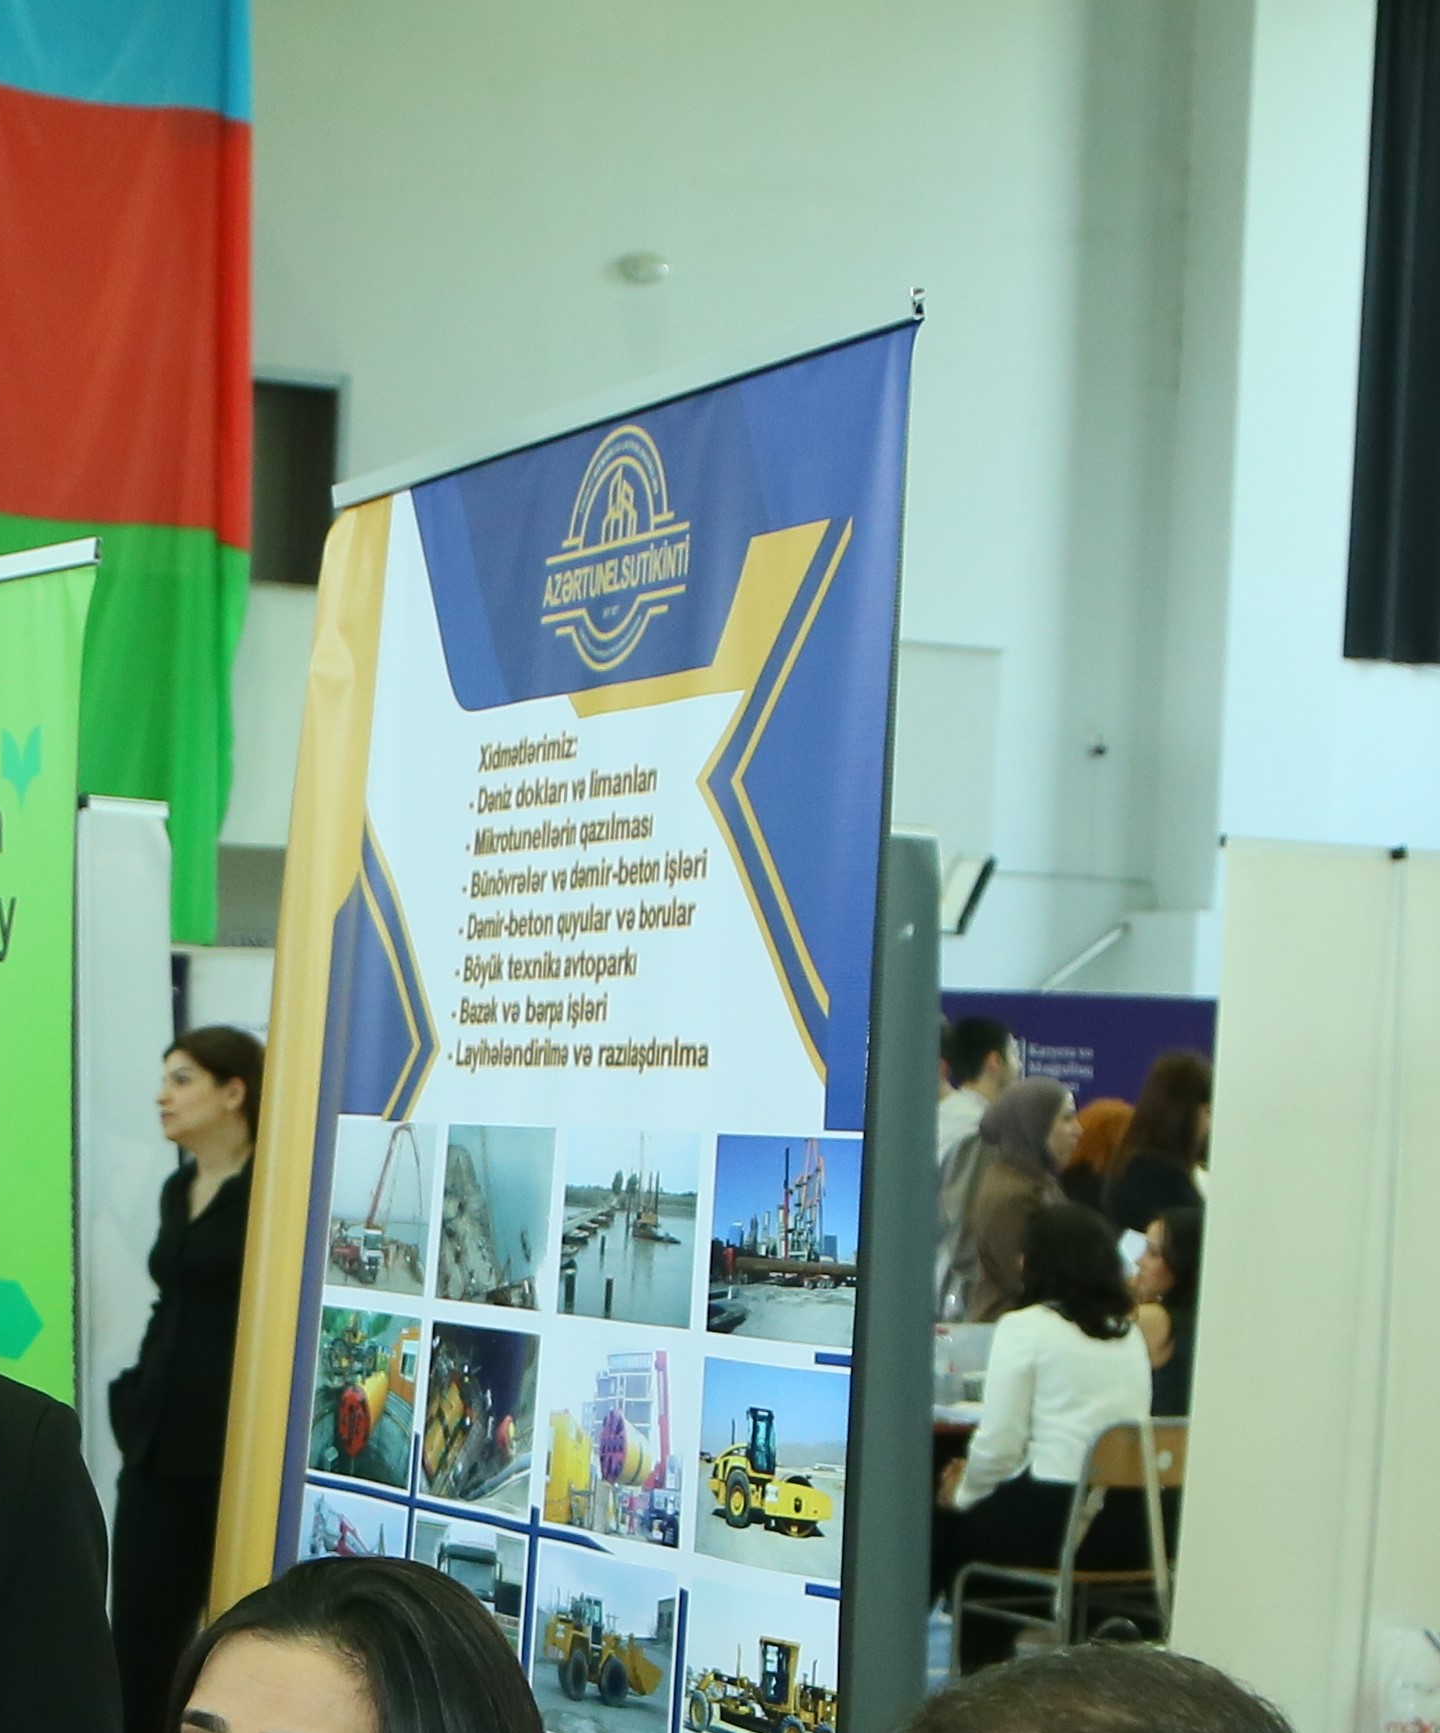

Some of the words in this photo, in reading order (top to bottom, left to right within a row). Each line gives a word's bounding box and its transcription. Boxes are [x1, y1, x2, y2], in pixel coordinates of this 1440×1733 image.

[571, 779, 586, 801] və
[552, 869, 568, 890] və
[664, 848, 708, 888] işləri
[616, 910, 636, 931] və
[639, 896, 697, 930] borular
[508, 953, 561, 980] texnika
[502, 1001, 520, 1023] və
[567, 991, 608, 1030] işləri
[574, 1043, 592, 1066] və
